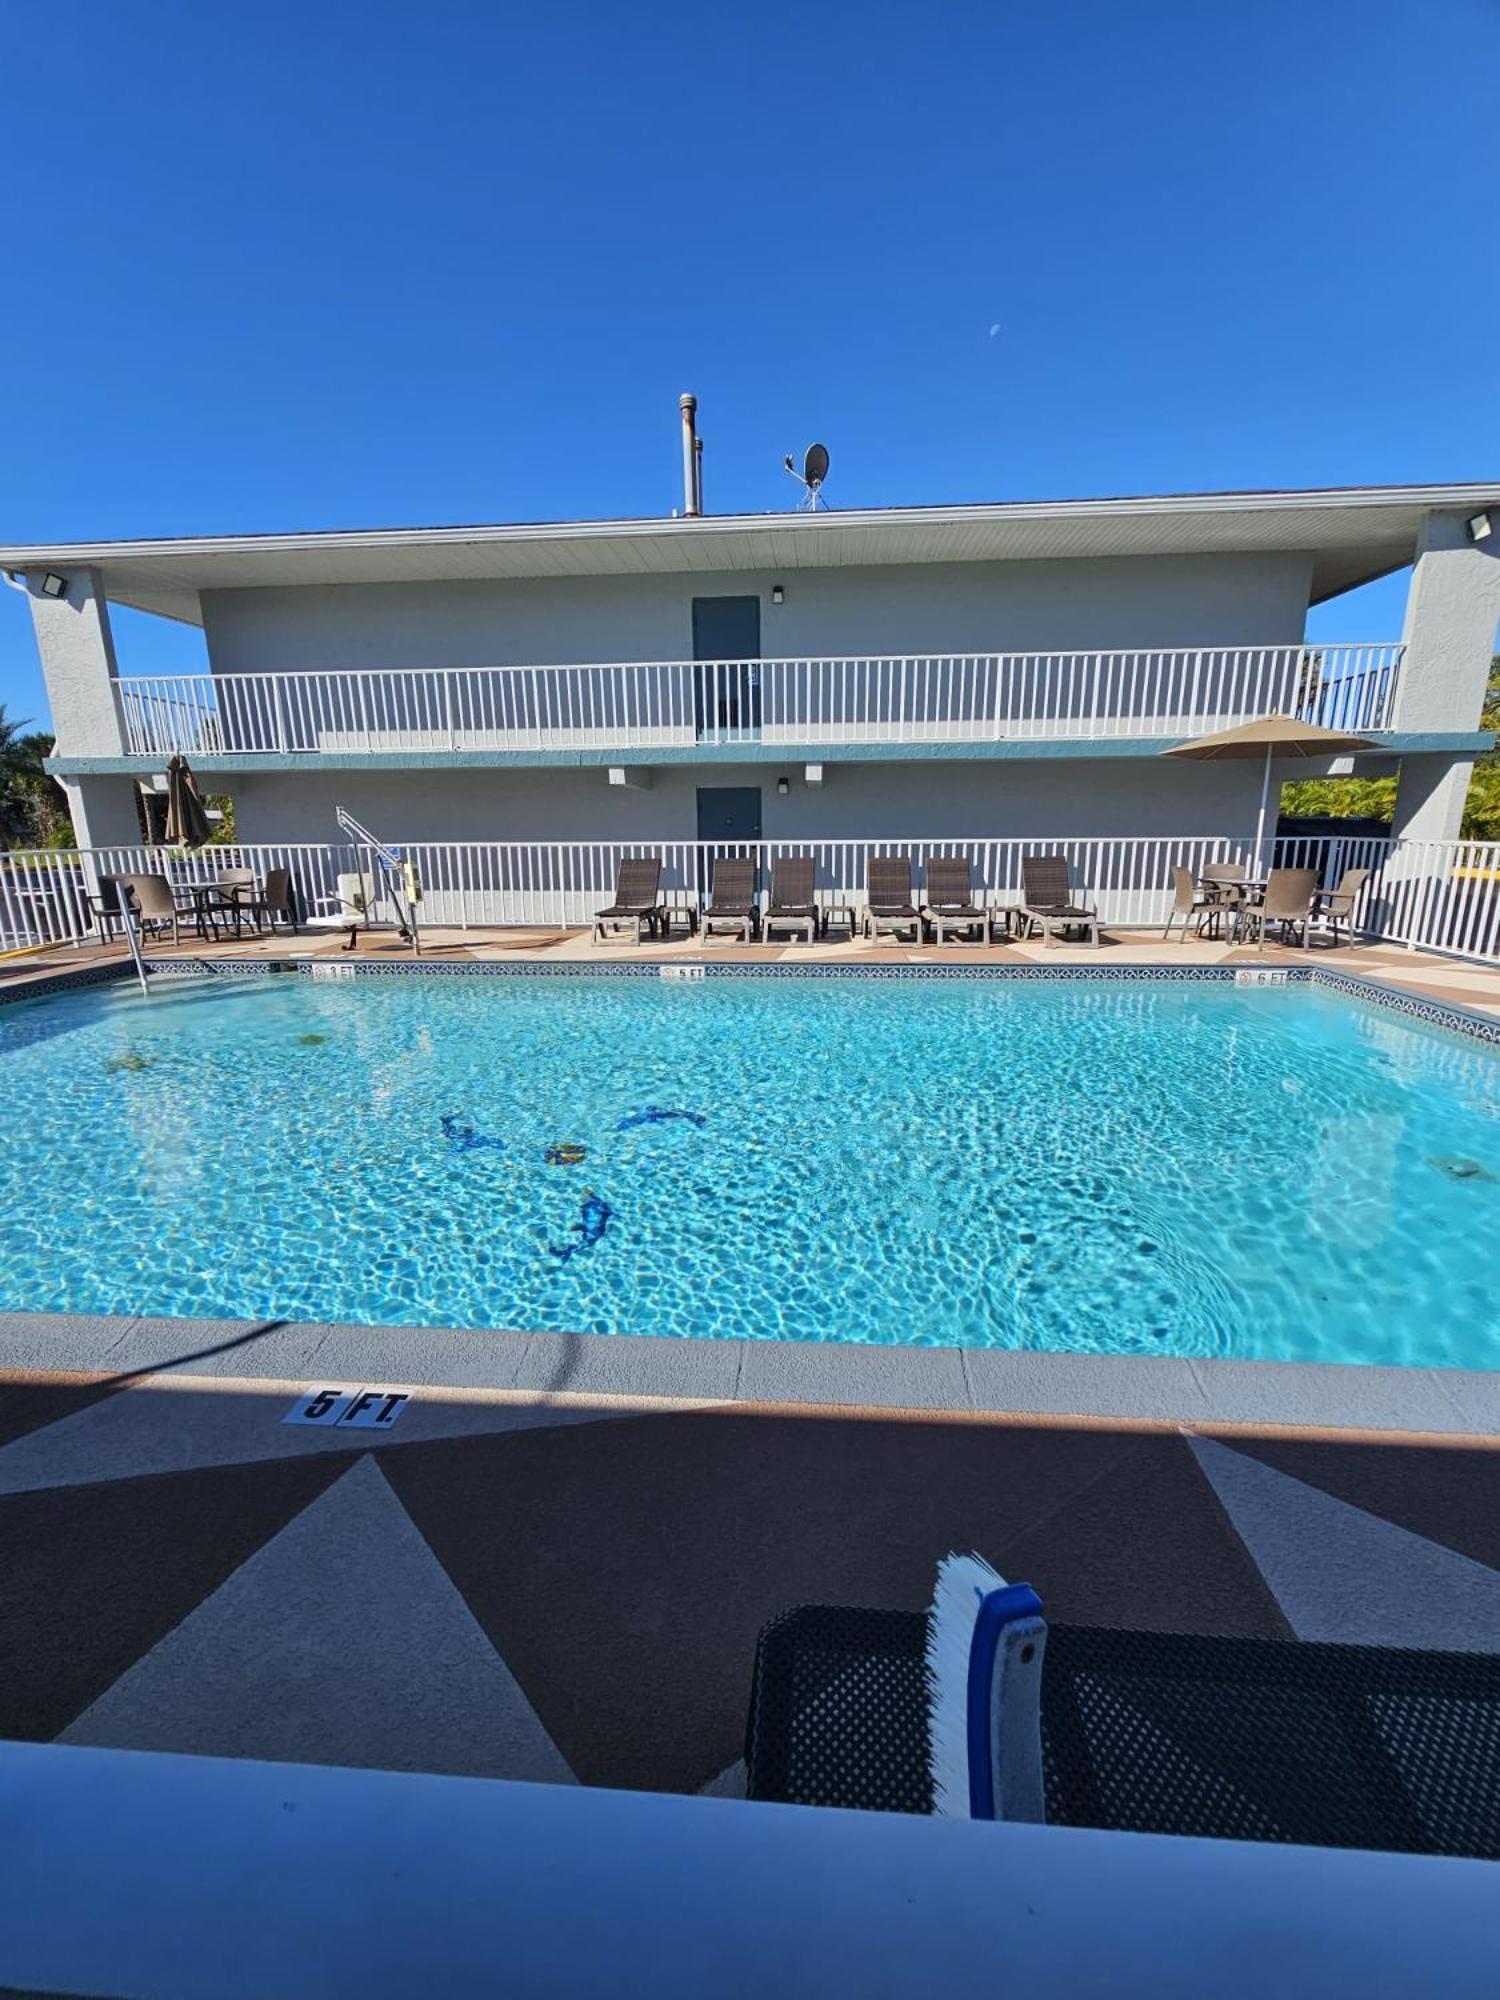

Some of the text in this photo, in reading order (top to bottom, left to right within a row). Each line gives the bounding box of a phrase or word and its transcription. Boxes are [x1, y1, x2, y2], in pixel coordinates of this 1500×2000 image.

[690, 969, 703, 977] FT
[304, 1390, 409, 1422] 5 FT.
